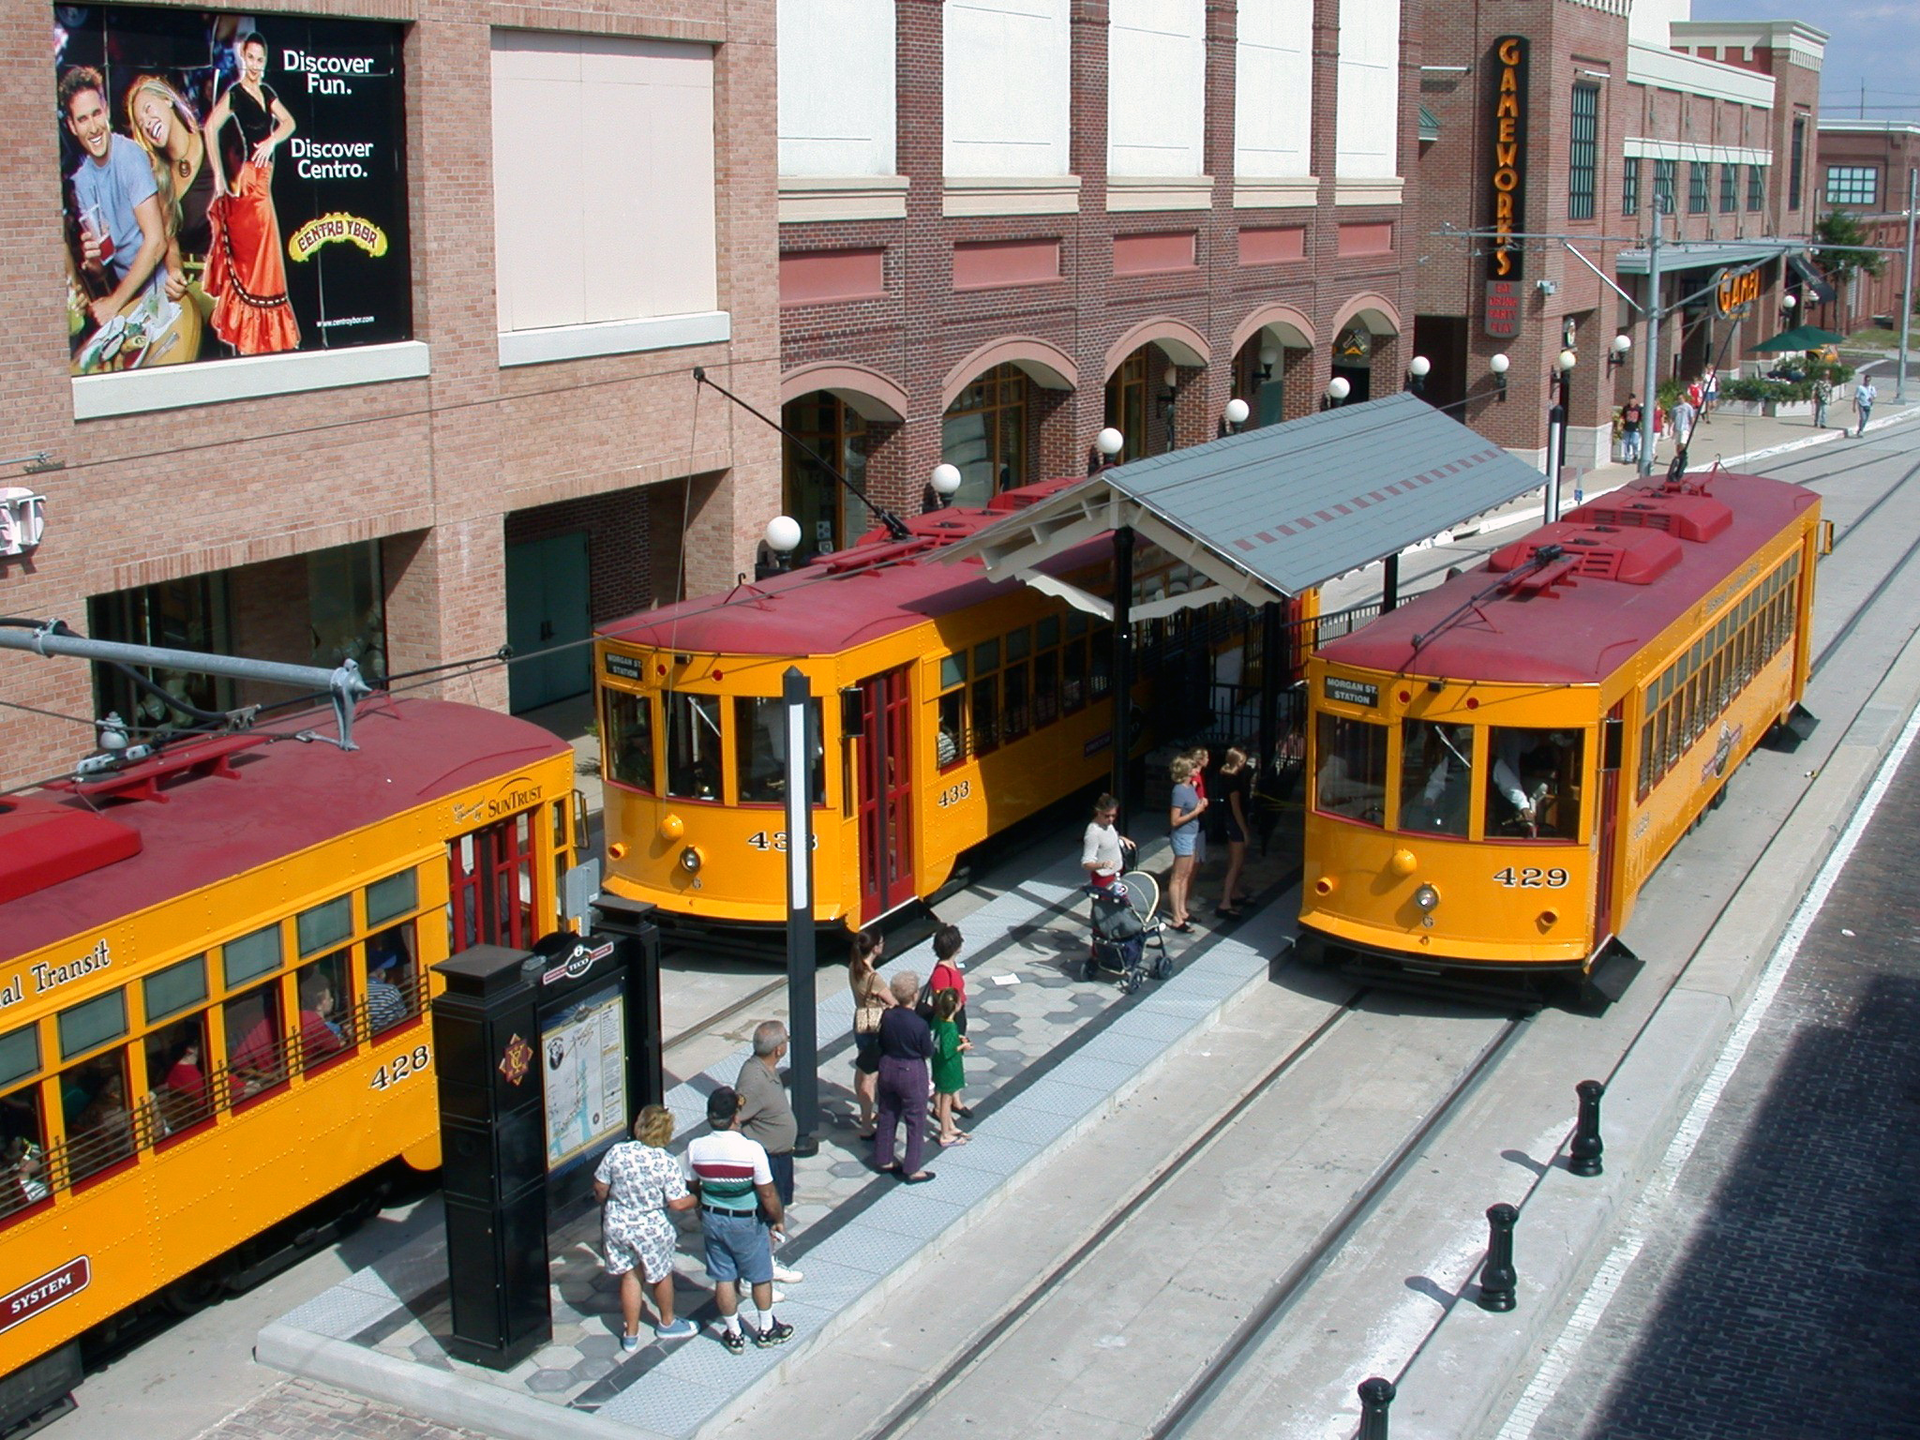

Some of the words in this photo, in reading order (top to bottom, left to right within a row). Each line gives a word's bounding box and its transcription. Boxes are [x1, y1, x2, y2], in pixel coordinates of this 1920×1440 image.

[282, 49, 375, 73] Discover
[307, 72, 353, 95] Fun.
[290, 138, 375, 159] Discover
[1493, 38, 1521, 276] GAMEWORKS
[297, 159, 369, 179] Centro.
[297, 220, 344, 253] CENTRO
[345, 220, 378, 249] YBOR
[1326, 677, 1364, 692] MORGAN
[1334, 690, 1371, 705] STATION
[936, 780, 971, 809] 433
[1492, 866, 1570, 889] 429
[0, 974, 25, 1009] al
[30, 938, 113, 995] Transit
[370, 1043, 431, 1092] 428
[11, 1272, 73, 1315] SYSTEM
